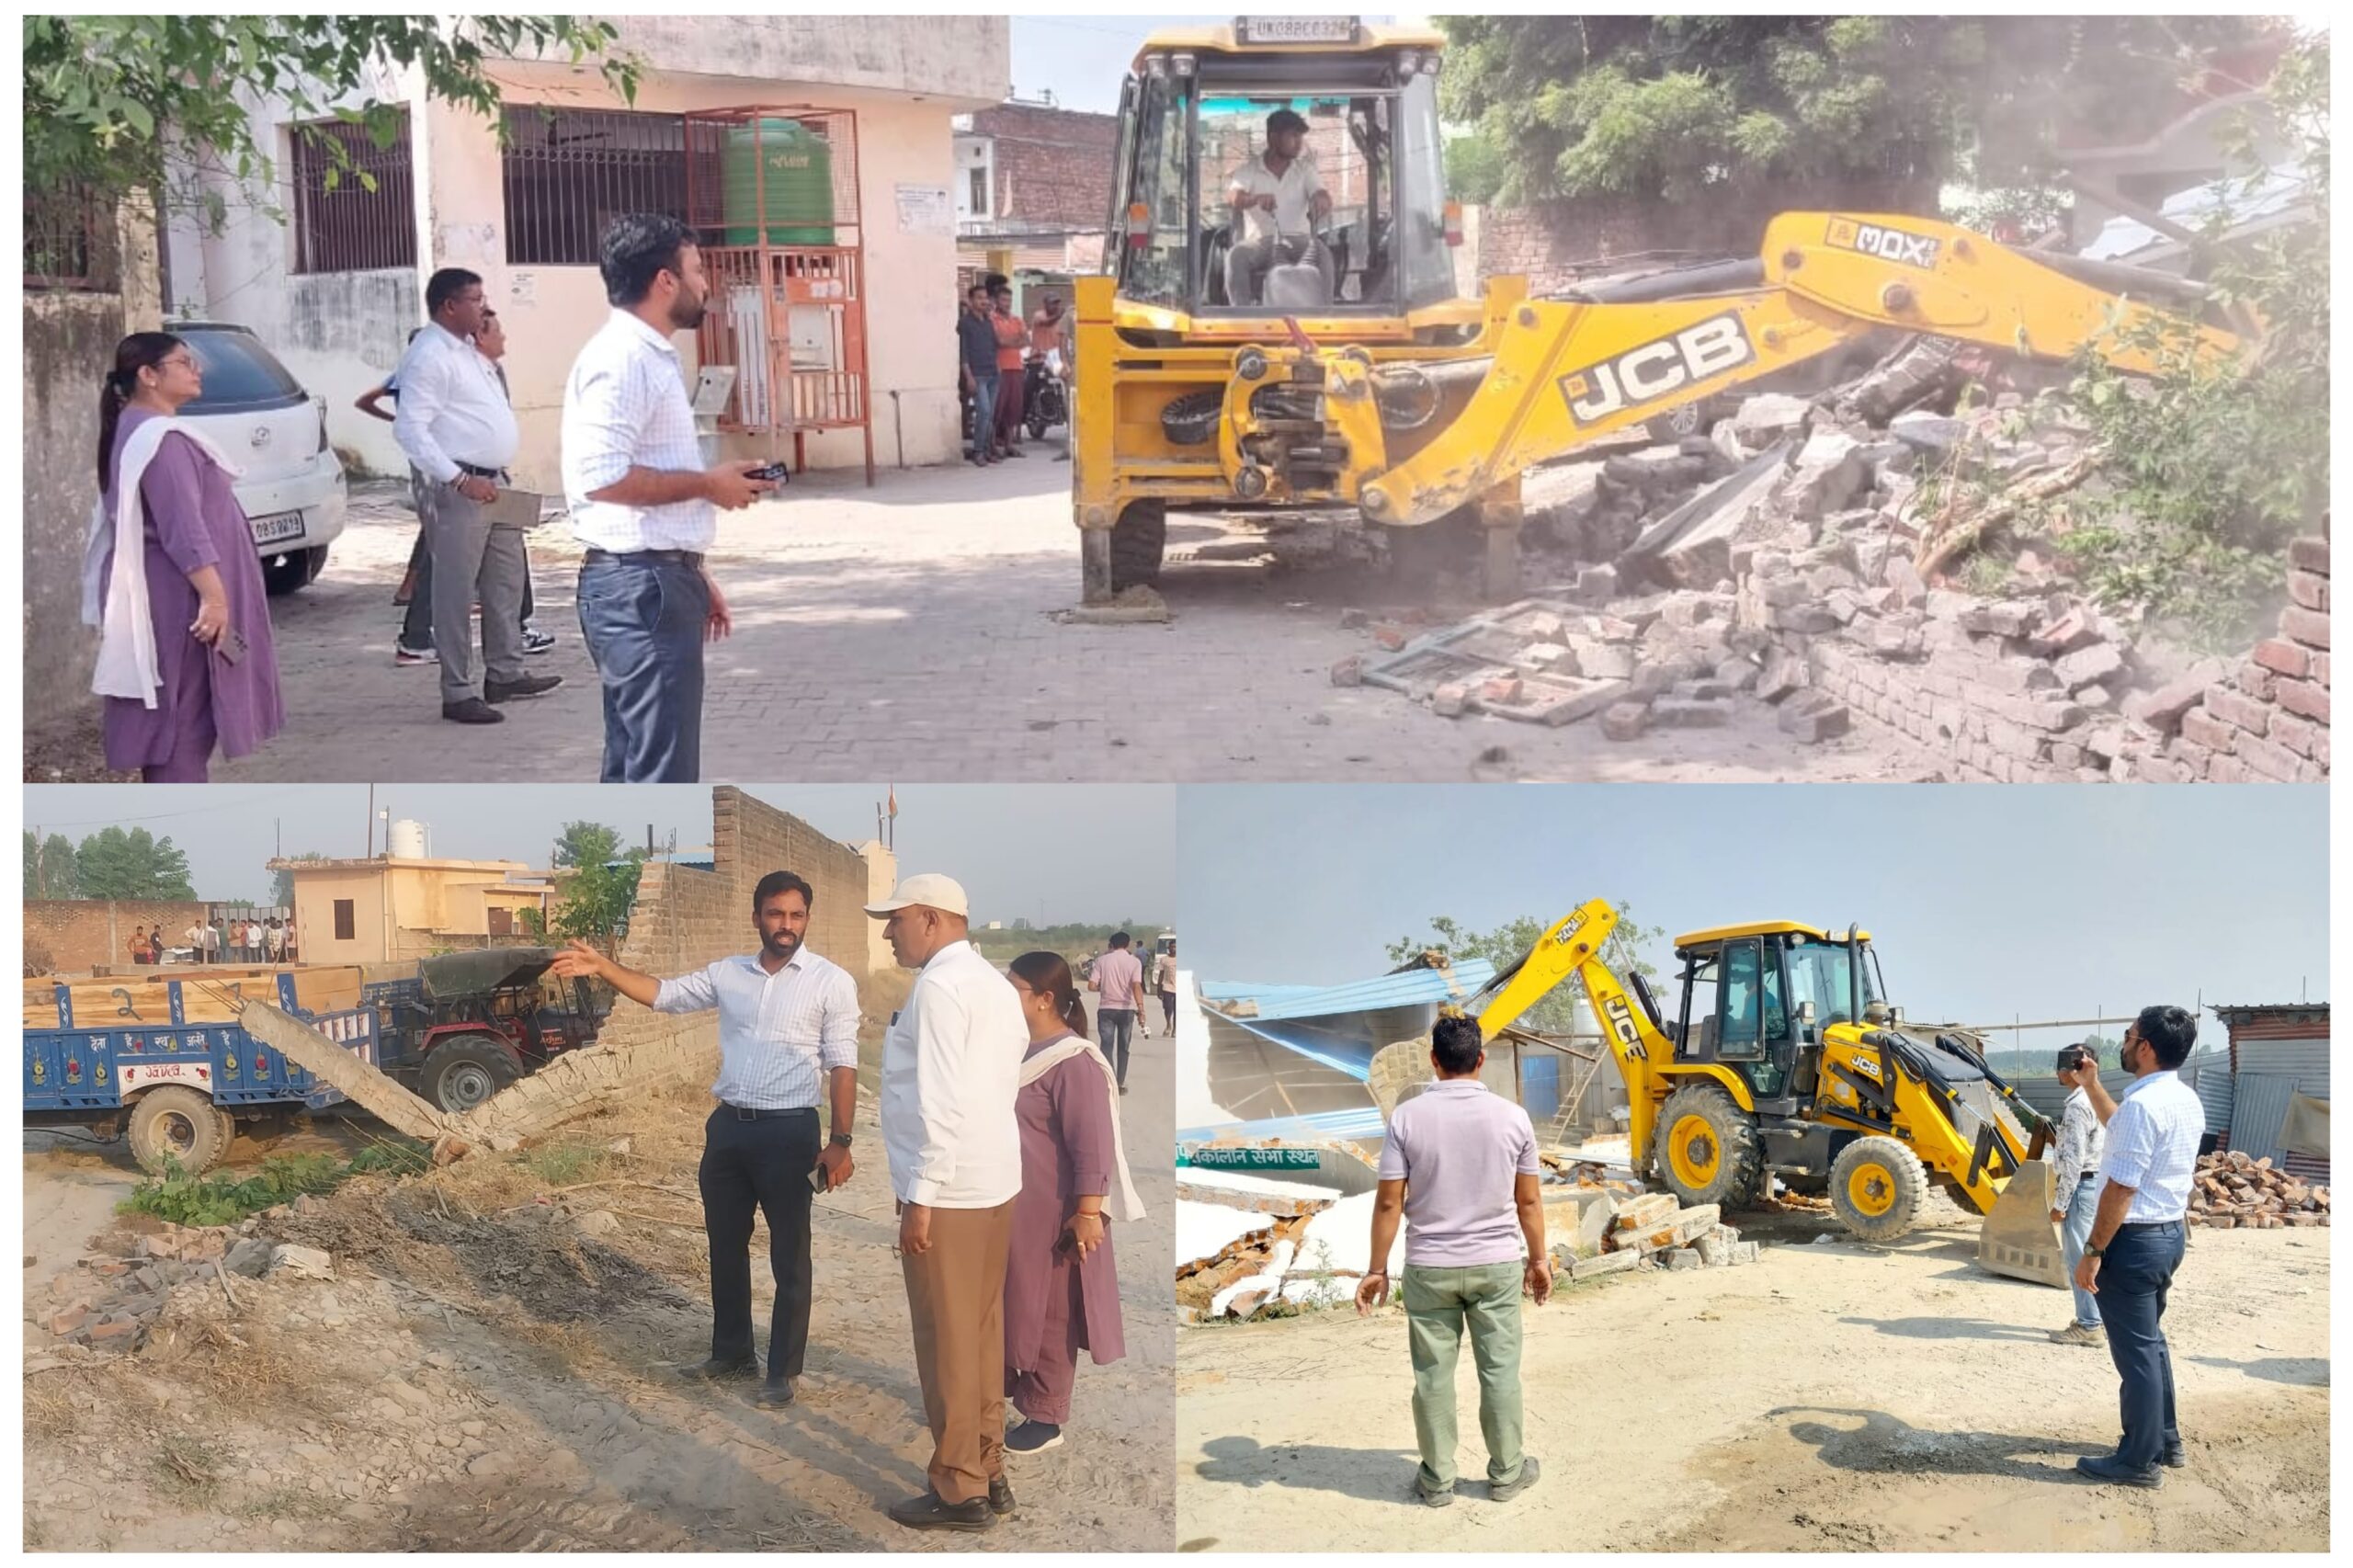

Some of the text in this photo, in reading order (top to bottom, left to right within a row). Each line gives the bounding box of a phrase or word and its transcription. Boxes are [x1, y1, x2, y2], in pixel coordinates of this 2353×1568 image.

[1573, 316, 1748, 421] JCB
[1851, 1056, 1880, 1076] JCB
[1250, 1150, 1284, 1165] सभा
[1287, 1150, 1320, 1165] स्थल
